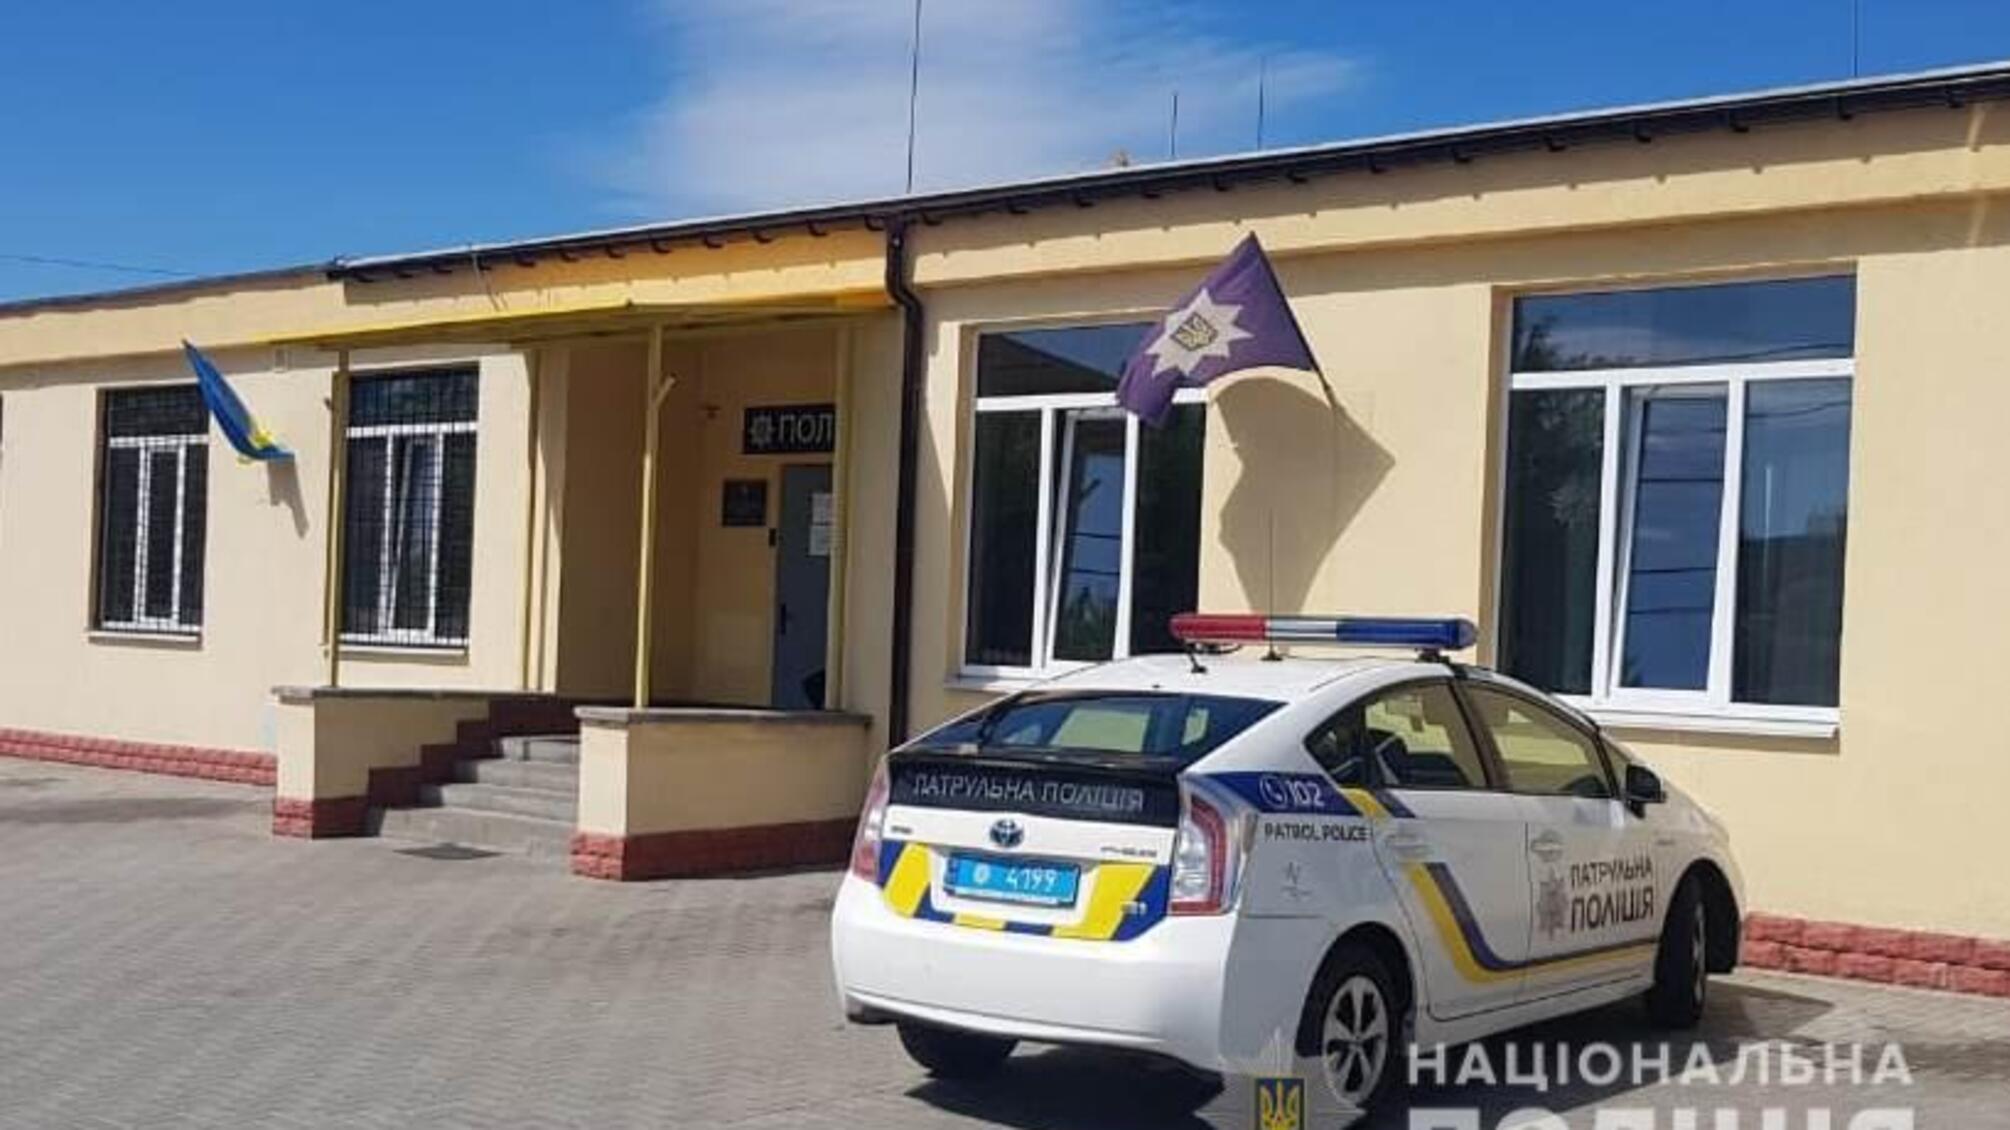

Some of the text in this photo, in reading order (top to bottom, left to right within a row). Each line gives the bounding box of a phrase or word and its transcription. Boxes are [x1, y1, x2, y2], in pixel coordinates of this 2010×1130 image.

[912, 773, 1144, 813] ПАТРУЛЬНА ПОЛІЦІЯ
[1287, 780, 1326, 808] 102
[1264, 822, 1369, 842] PATROL POLICE
[1006, 867, 1058, 893] 4199
[1571, 856, 1653, 888] ПАТРУЛЬНА
[1571, 886, 1654, 933] ПОЛІЦІЯ
